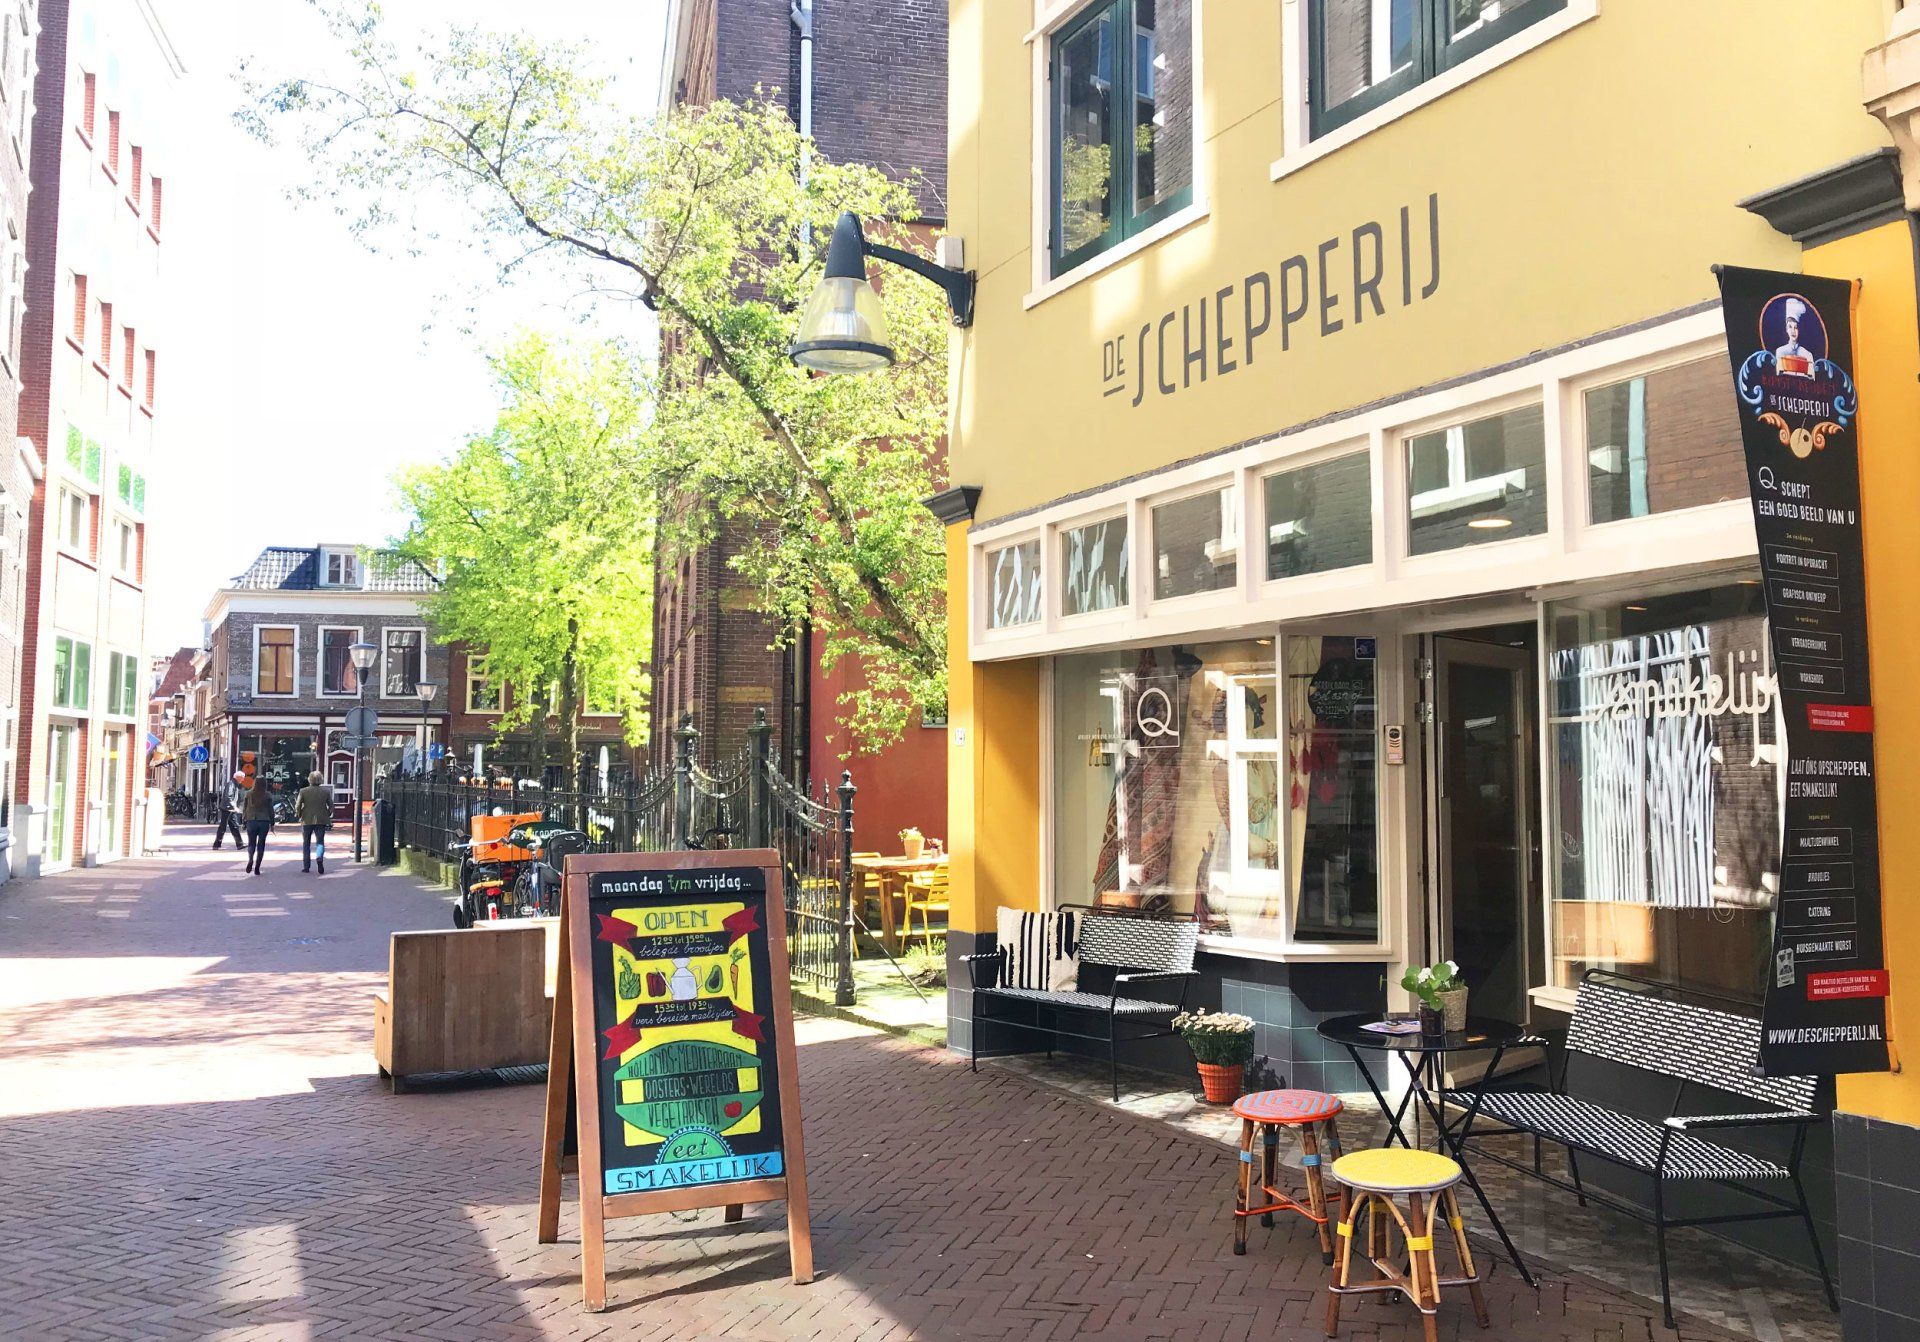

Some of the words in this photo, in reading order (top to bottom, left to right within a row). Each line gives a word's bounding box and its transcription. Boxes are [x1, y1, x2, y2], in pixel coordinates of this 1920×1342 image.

[1103, 333, 1126, 388] DE
[1132, 192, 1440, 408] SCHEPPERIJ
[1778, 395, 1830, 418] SCHEPPERIJ
[1758, 466, 1777, 491] Q
[1781, 481, 1811, 499] SCHEPT
[1759, 500, 1775, 516] EEN
[1776, 502, 1798, 519] GOED
[1800, 505, 1824, 522] BEELD
[1826, 508, 1845, 525] VAN
[1848, 510, 1855, 525] U
[1775, 553, 1797, 565] PORTRET
[1804, 557, 1828, 570] OPDRACHT
[1782, 587, 1806, 600] GRAFISCH
[1137, 687, 1180, 738] Q
[1791, 759, 1805, 775] LAAT
[1790, 782, 1801, 798] EET
[1802, 782, 1838, 798] SMAKELIJK!
[602, 876, 663, 894] maandag
[667, 874, 692, 892] t/m
[644, 909, 710, 931] OPEN
[639, 944, 679, 957] belegde
[683, 942, 725, 955] broodjes
[1796, 940, 1834, 954] HUISGEMAAKTE
[1834, 940, 1852, 951] WORST
[634, 1016, 654, 1025] vers
[656, 1012, 690, 1024] bereide
[1768, 1024, 1882, 1045] WWW.DESCHEPPERIJ.NL
[647, 1098, 720, 1129] VEGETARISCH
[672, 1137, 709, 1159] eet
[617, 1156, 771, 1191] SMAKELIJK
